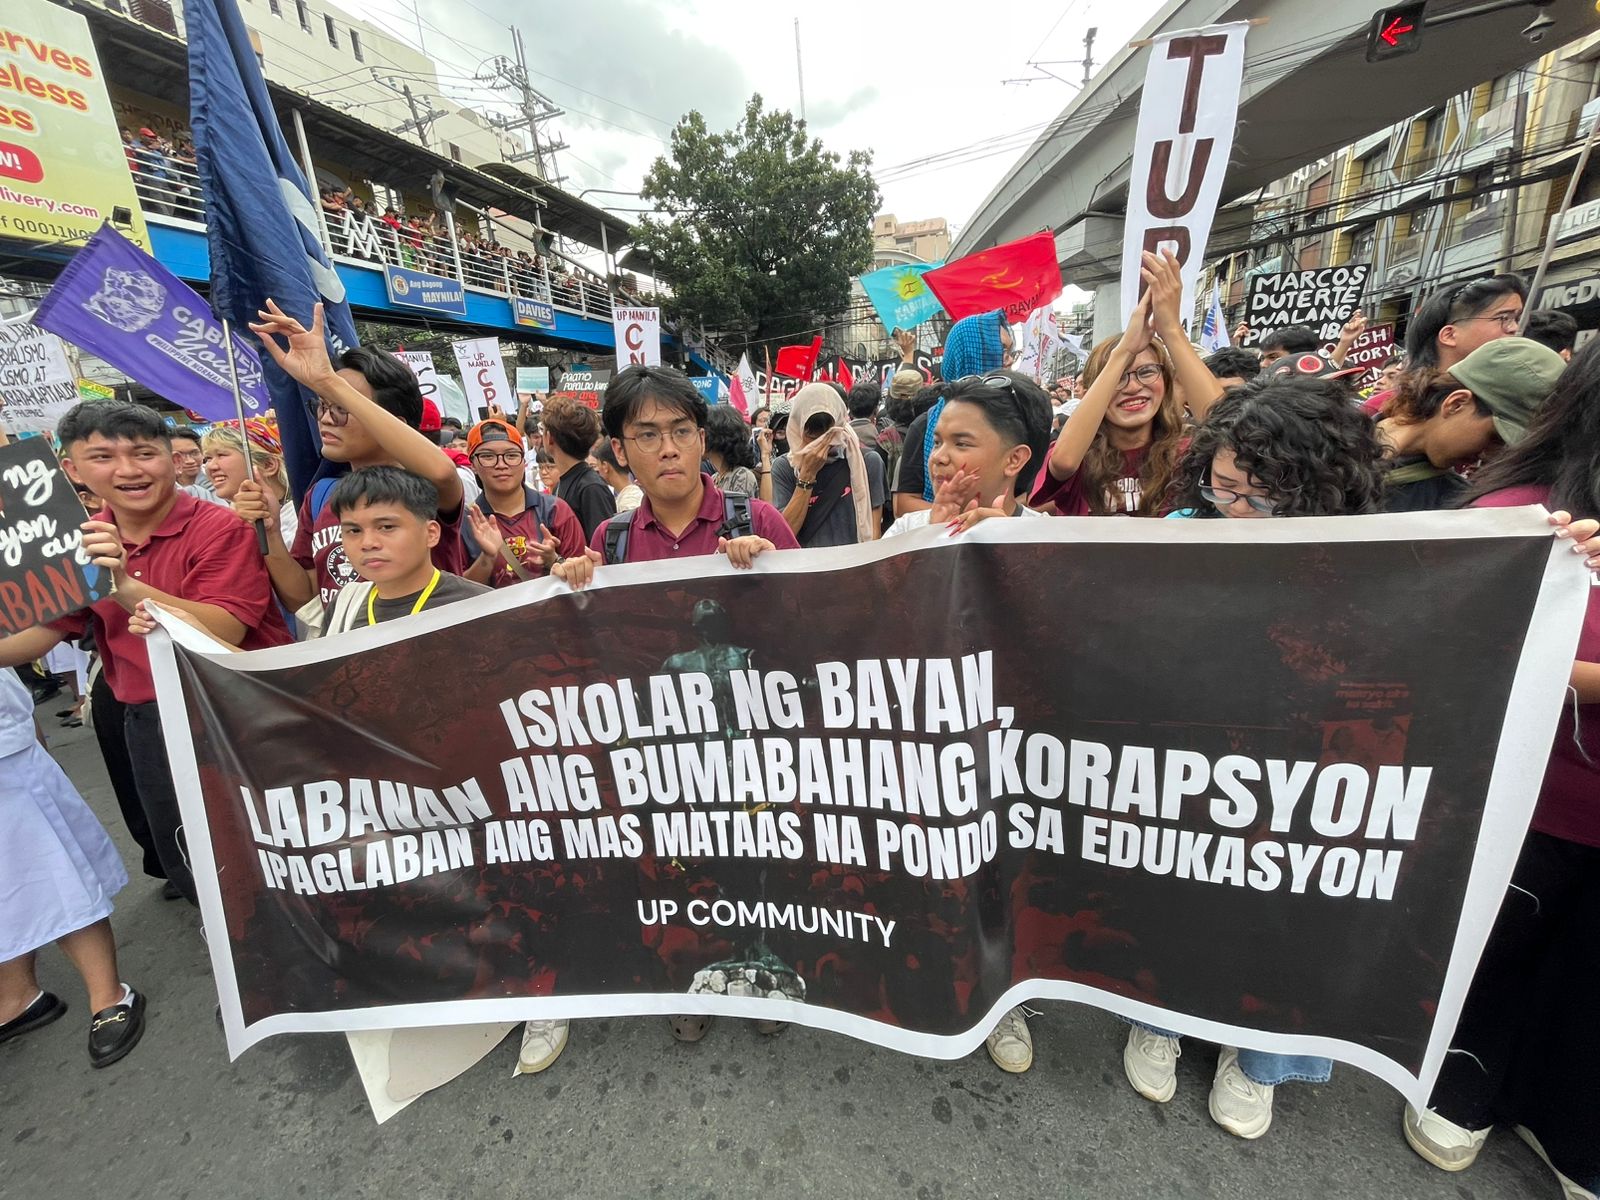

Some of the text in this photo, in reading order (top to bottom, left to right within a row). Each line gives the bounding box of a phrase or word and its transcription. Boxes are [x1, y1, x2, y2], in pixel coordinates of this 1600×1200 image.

[409, 280, 443, 290] Ang Bagong
[1256, 266, 1367, 292] MARCOS
[422, 291, 463, 303] MAYNILA!
[1252, 287, 1360, 310] DUTERTE
[1538, 278, 1600, 312] McD
[518, 301, 552, 320] DAVIES
[616, 311, 657, 321] UP MANILA
[1250, 304, 1351, 327] WALANG
[468, 361, 496, 369] MANILA
[474, 353, 485, 361] UP
[3, 459, 57, 506] ng
[499, 650, 1014, 749] ISKOLAR NG BAYAN,
[240, 728, 1433, 848] LABANAN ANG BUMABAHANG KORAPSYON
[257, 802, 1403, 900] IPAGLABAN ANG MAS MATAAS NA PONDO SA EDUKASYON
[637, 900, 896, 948] UP COMMUNITY
